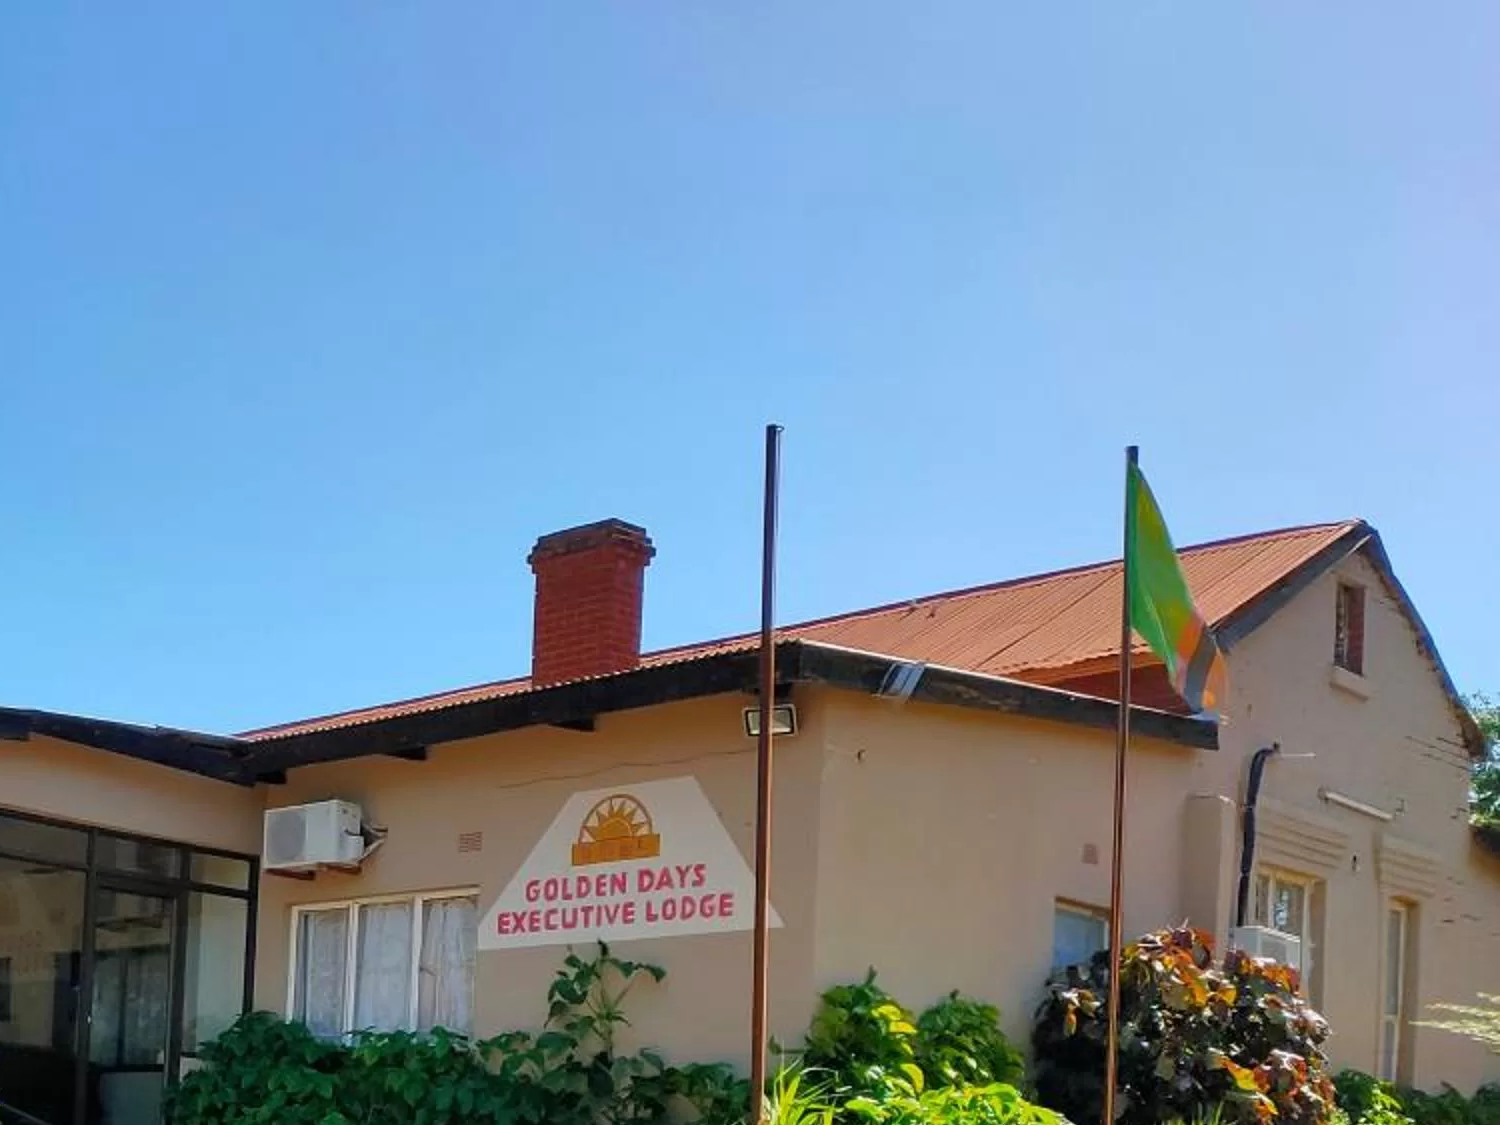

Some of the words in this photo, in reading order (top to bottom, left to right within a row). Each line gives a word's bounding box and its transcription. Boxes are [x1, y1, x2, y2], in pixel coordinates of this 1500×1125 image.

[525, 871, 627, 902] GOLDEN
[636, 863, 706, 893] DAYS
[497, 902, 636, 935] EXECUTIVE
[645, 893, 734, 922] LODGE
